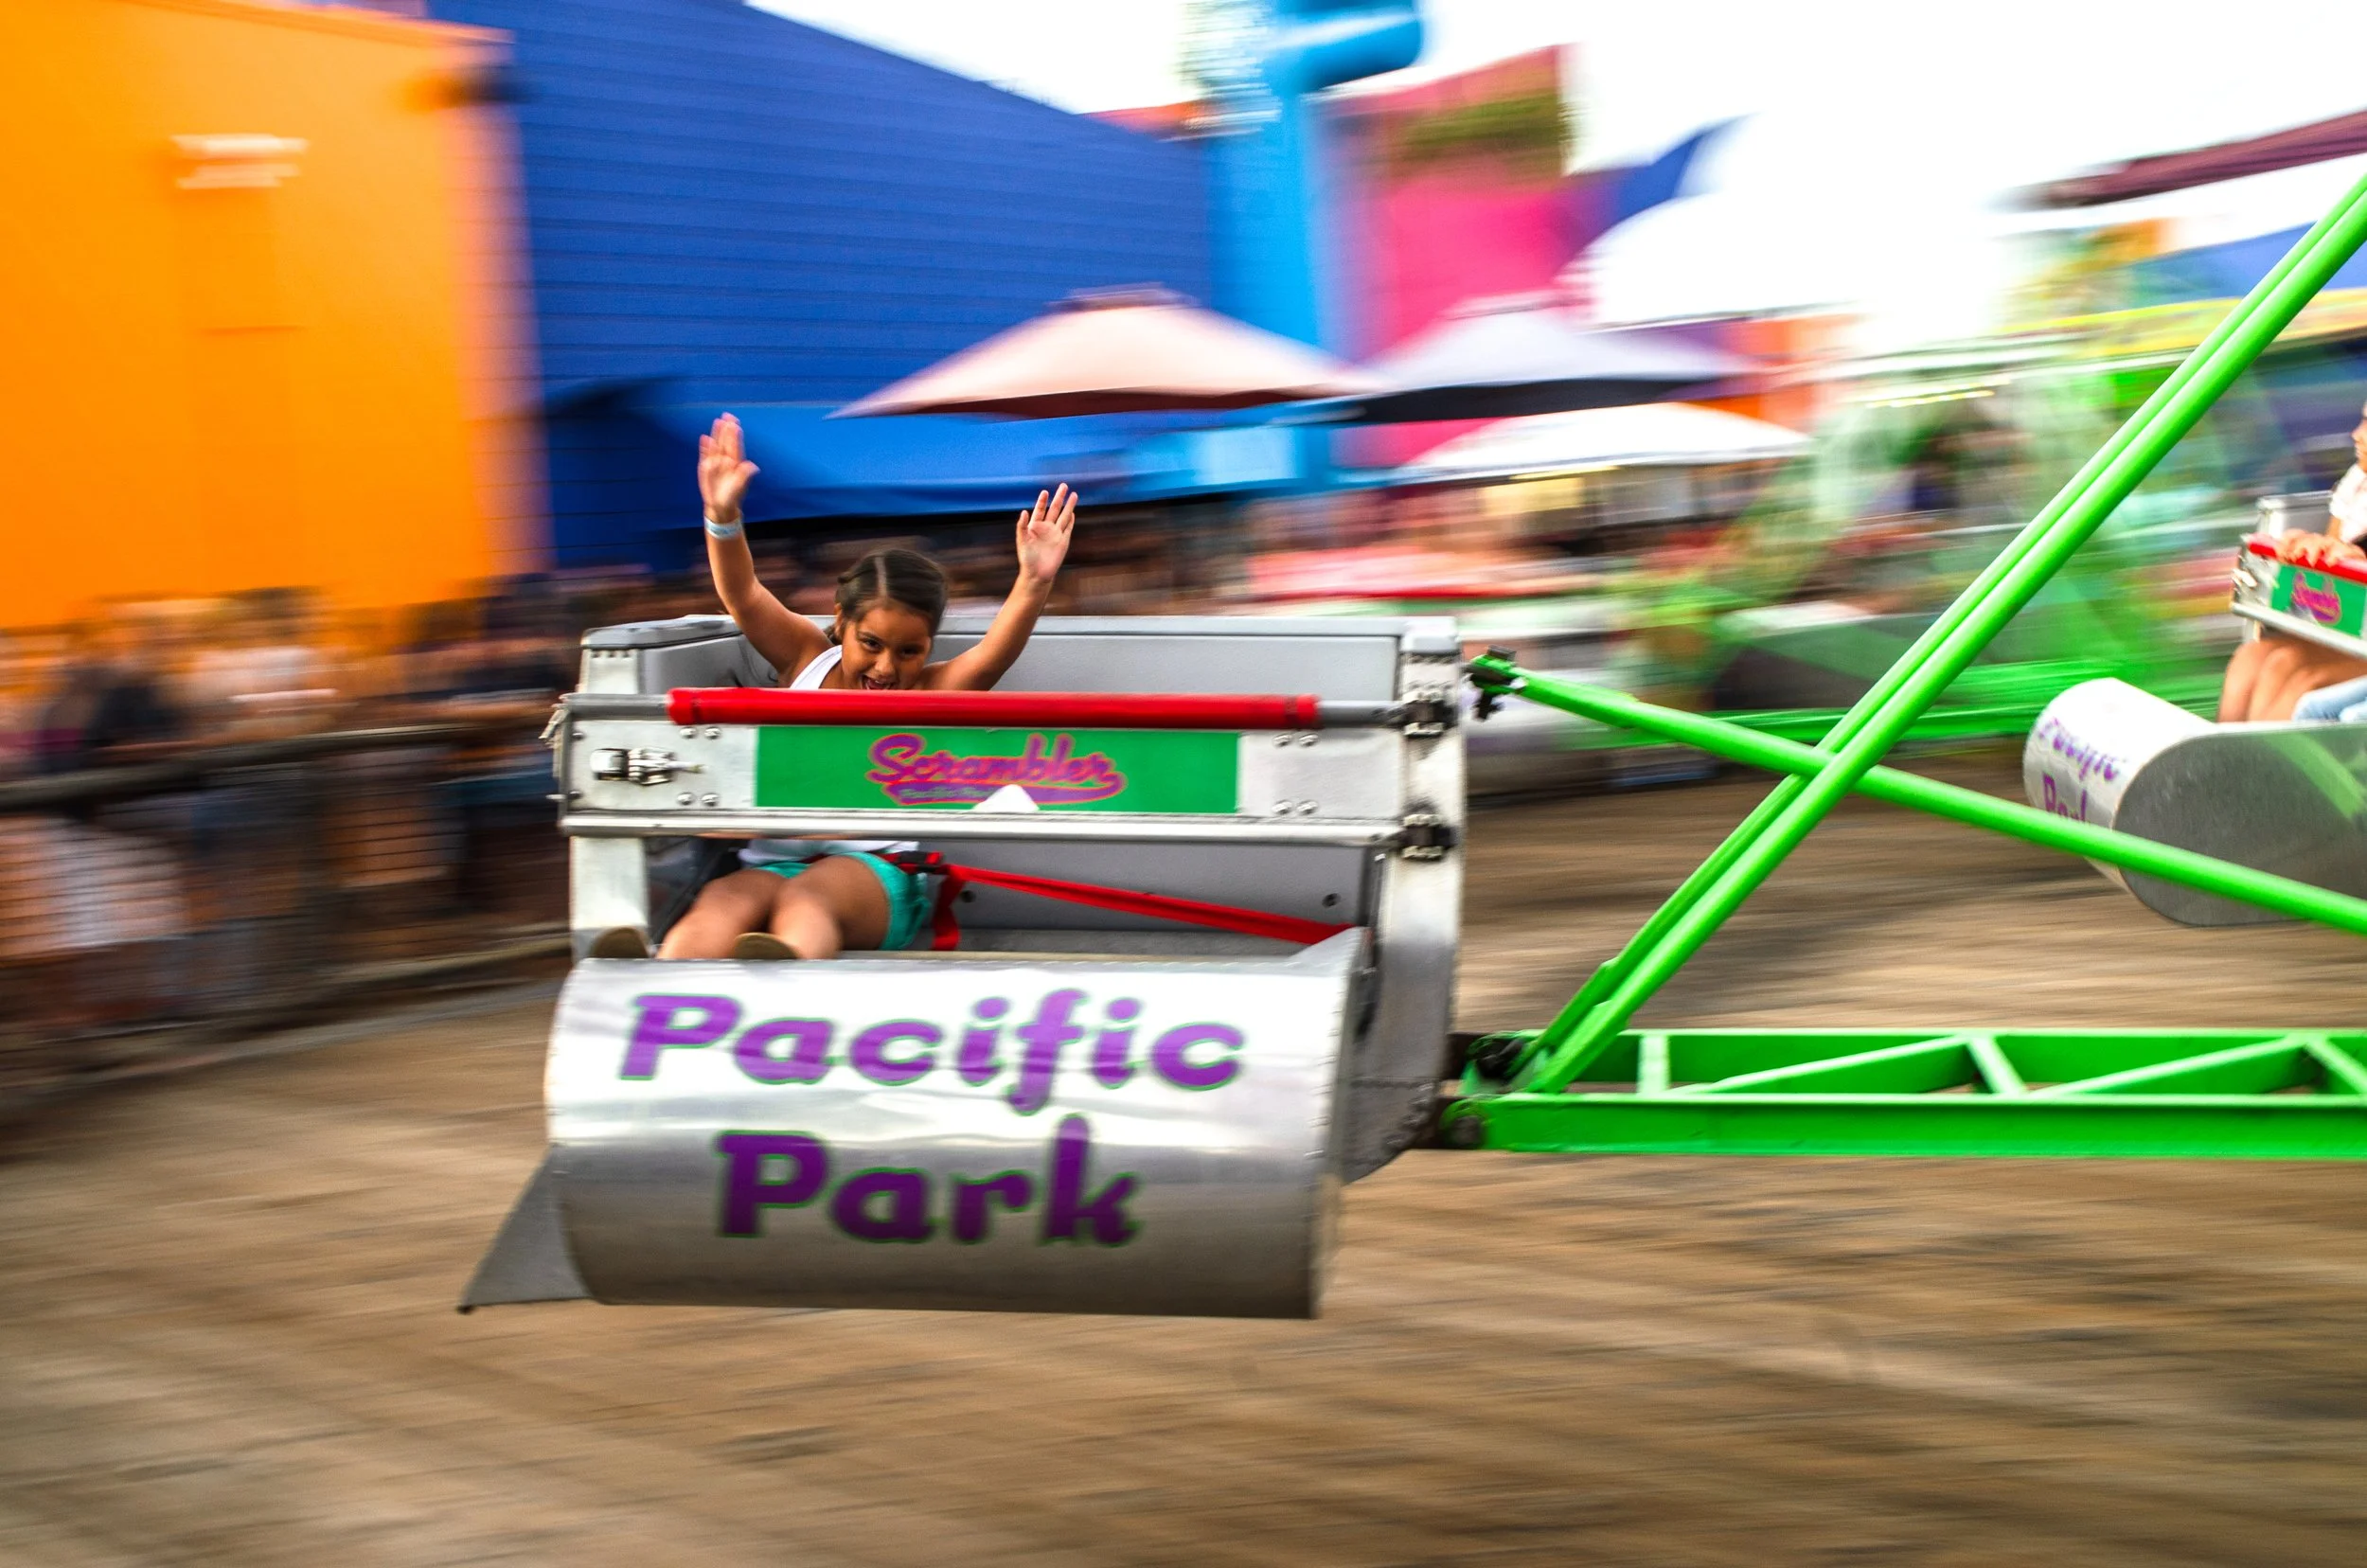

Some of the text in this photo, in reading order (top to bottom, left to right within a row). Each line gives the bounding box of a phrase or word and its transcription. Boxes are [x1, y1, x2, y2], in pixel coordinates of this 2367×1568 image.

[865, 733, 1127, 788] Scrambler
[619, 988, 1246, 1114] Pacific
[714, 1114, 1140, 1247] Park
